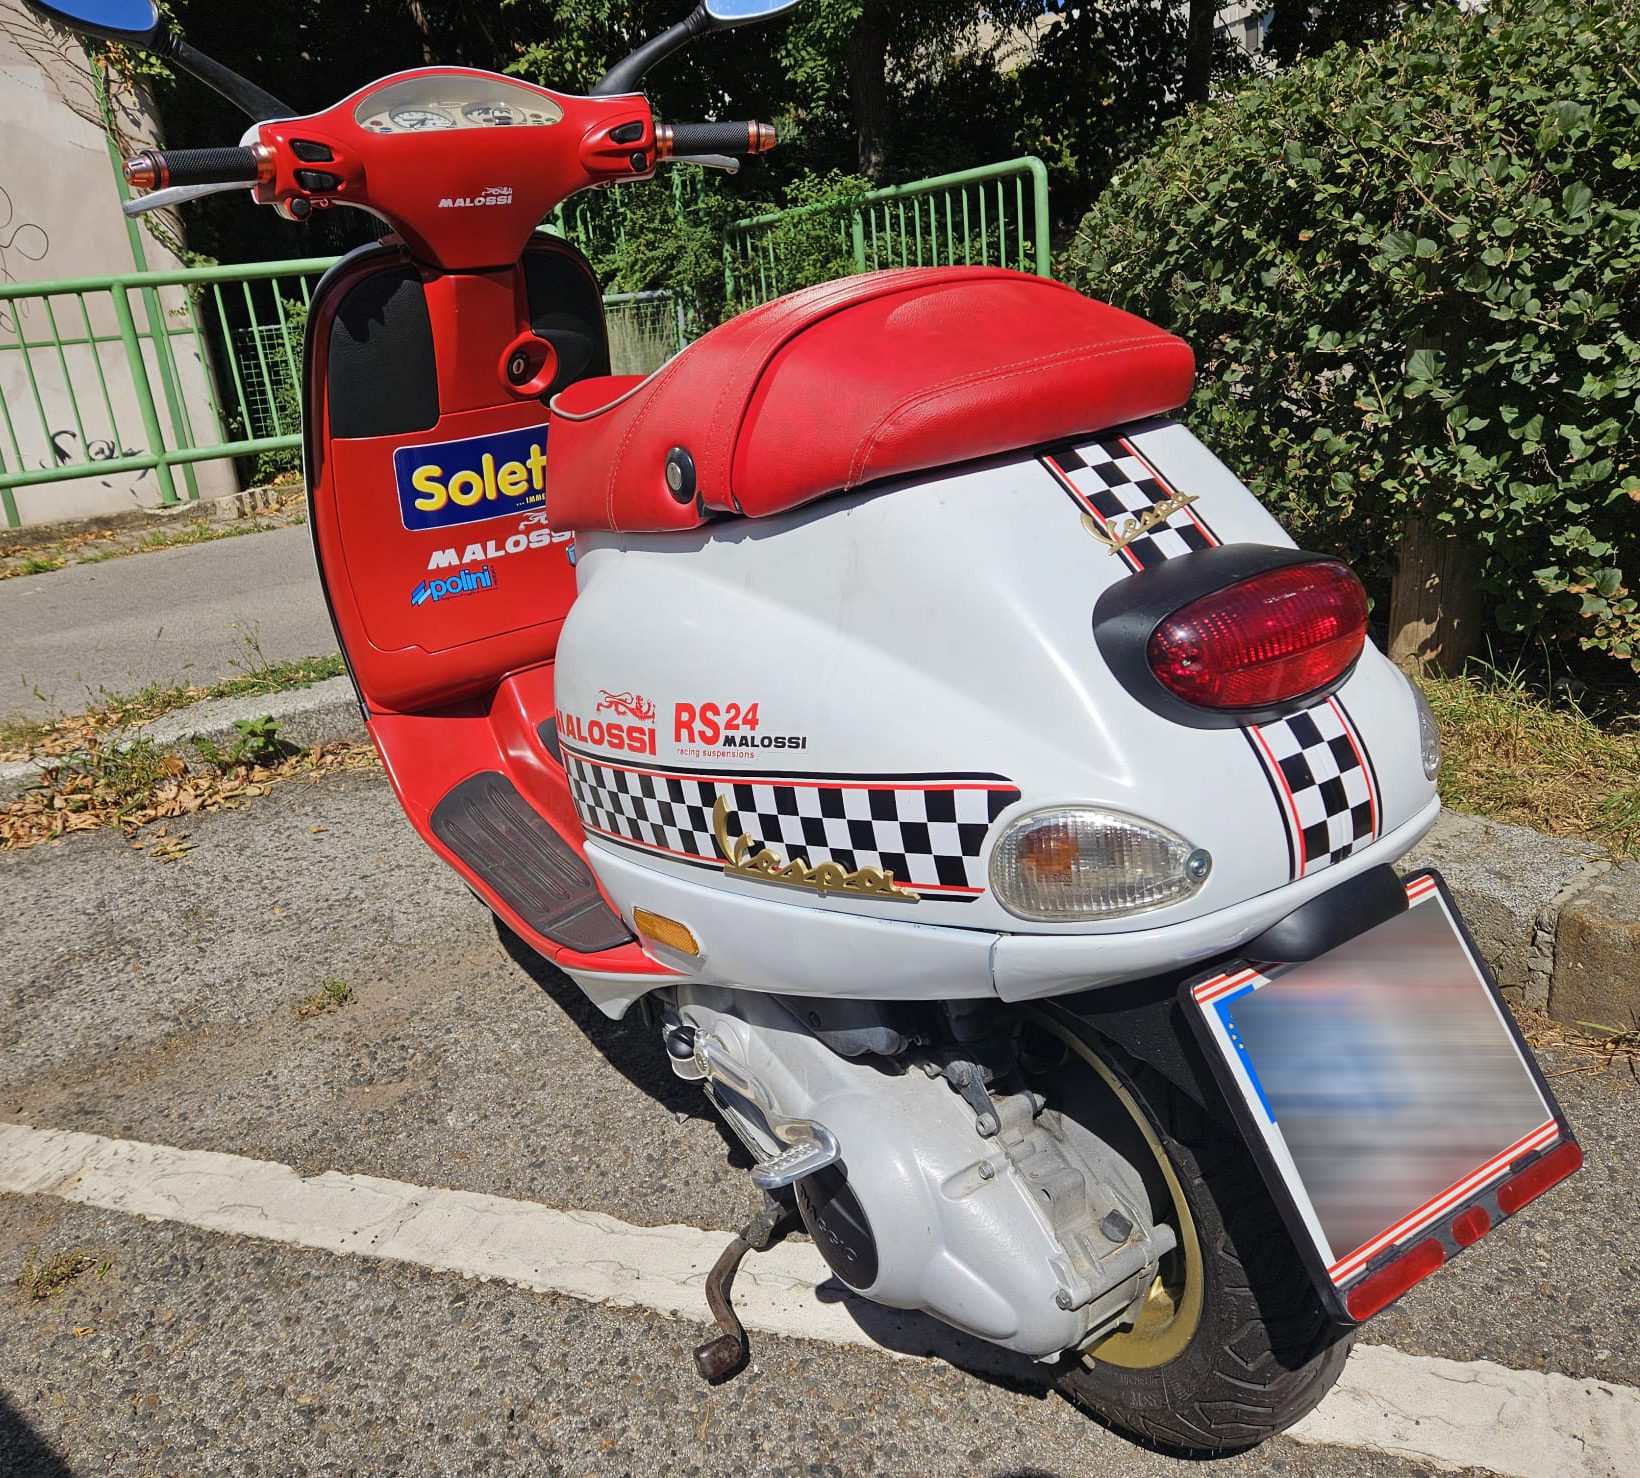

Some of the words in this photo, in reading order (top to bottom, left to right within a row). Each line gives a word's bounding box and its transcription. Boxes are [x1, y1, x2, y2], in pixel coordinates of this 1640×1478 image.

[438, 195, 512, 207] MALOSSI
[411, 443, 547, 512] Solet
[1080, 491, 1200, 557] Vespa
[429, 565, 493, 602] polini
[677, 748, 700, 759] racing
[702, 750, 755, 759] suspensions
[722, 735, 807, 749] MALOSSI
[712, 793, 921, 904] Vespa
